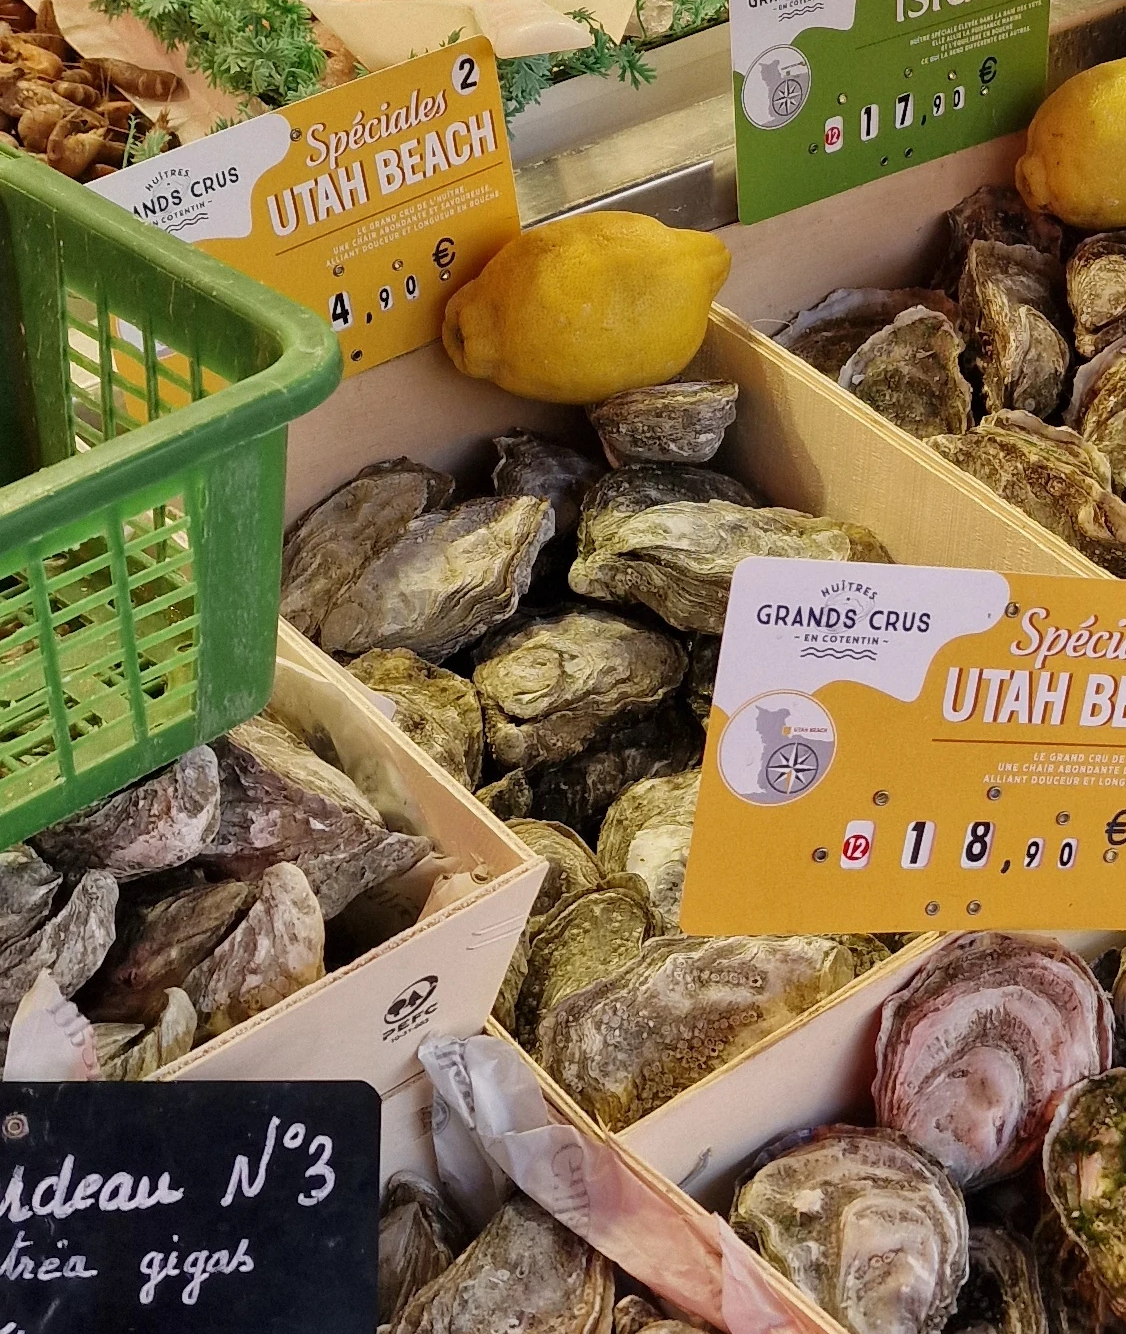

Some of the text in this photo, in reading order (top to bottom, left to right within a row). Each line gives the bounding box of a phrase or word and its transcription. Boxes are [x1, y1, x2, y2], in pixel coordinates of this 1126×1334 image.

[459, 58, 477, 90] 2
[305, 88, 448, 170] Spéciales
[145, 169, 190, 191] HUÎTRES
[266, 110, 499, 237] UTAH BEACH
[133, 167, 239, 219] ANDS CRUS
[161, 201, 205, 224] COTENTIN
[352, 232, 377, 247] CHAIR
[379, 211, 427, 235] ABONDANTE
[429, 205, 438, 216] ET
[369, 214, 397, 231] GRAND
[400, 206, 415, 217] CRU
[417, 201, 427, 211] DE
[326, 249, 359, 267] ALLIANT
[362, 232, 400, 252] DOUCEUR
[402, 228, 411, 236] ET
[414, 210, 454, 231] LONGUEUR
[432, 238, 456, 267] €
[821, 579, 878, 600] HUÎTRES
[757, 604, 931, 633] GRANDS CRUS
[804, 633, 879, 645] EN COTENTIN
[941, 667, 1076, 727] UTAH
[997, 762, 1019, 772] UNE
[1022, 763, 1054, 773] CHAIR
[1058, 764, 1120, 775] ABONDANTE
[1033, 752, 1046, 762] LE
[1049, 752, 1085, 763] GRAND
[1088, 754, 1108, 763] CRU
[1111, 755, 1125, 764] DE
[983, 774, 1027, 785] ALLIANT
[1030, 775, 1080, 786] DOUCEUR
[1082, 776, 1095, 786] ET
[845, 836, 868, 858] 12
[383, 1002, 438, 1041] PEFC
[0, 1153, 184, 1222] rdeau
[0, 1229, 254, 1305] trëa gigas
